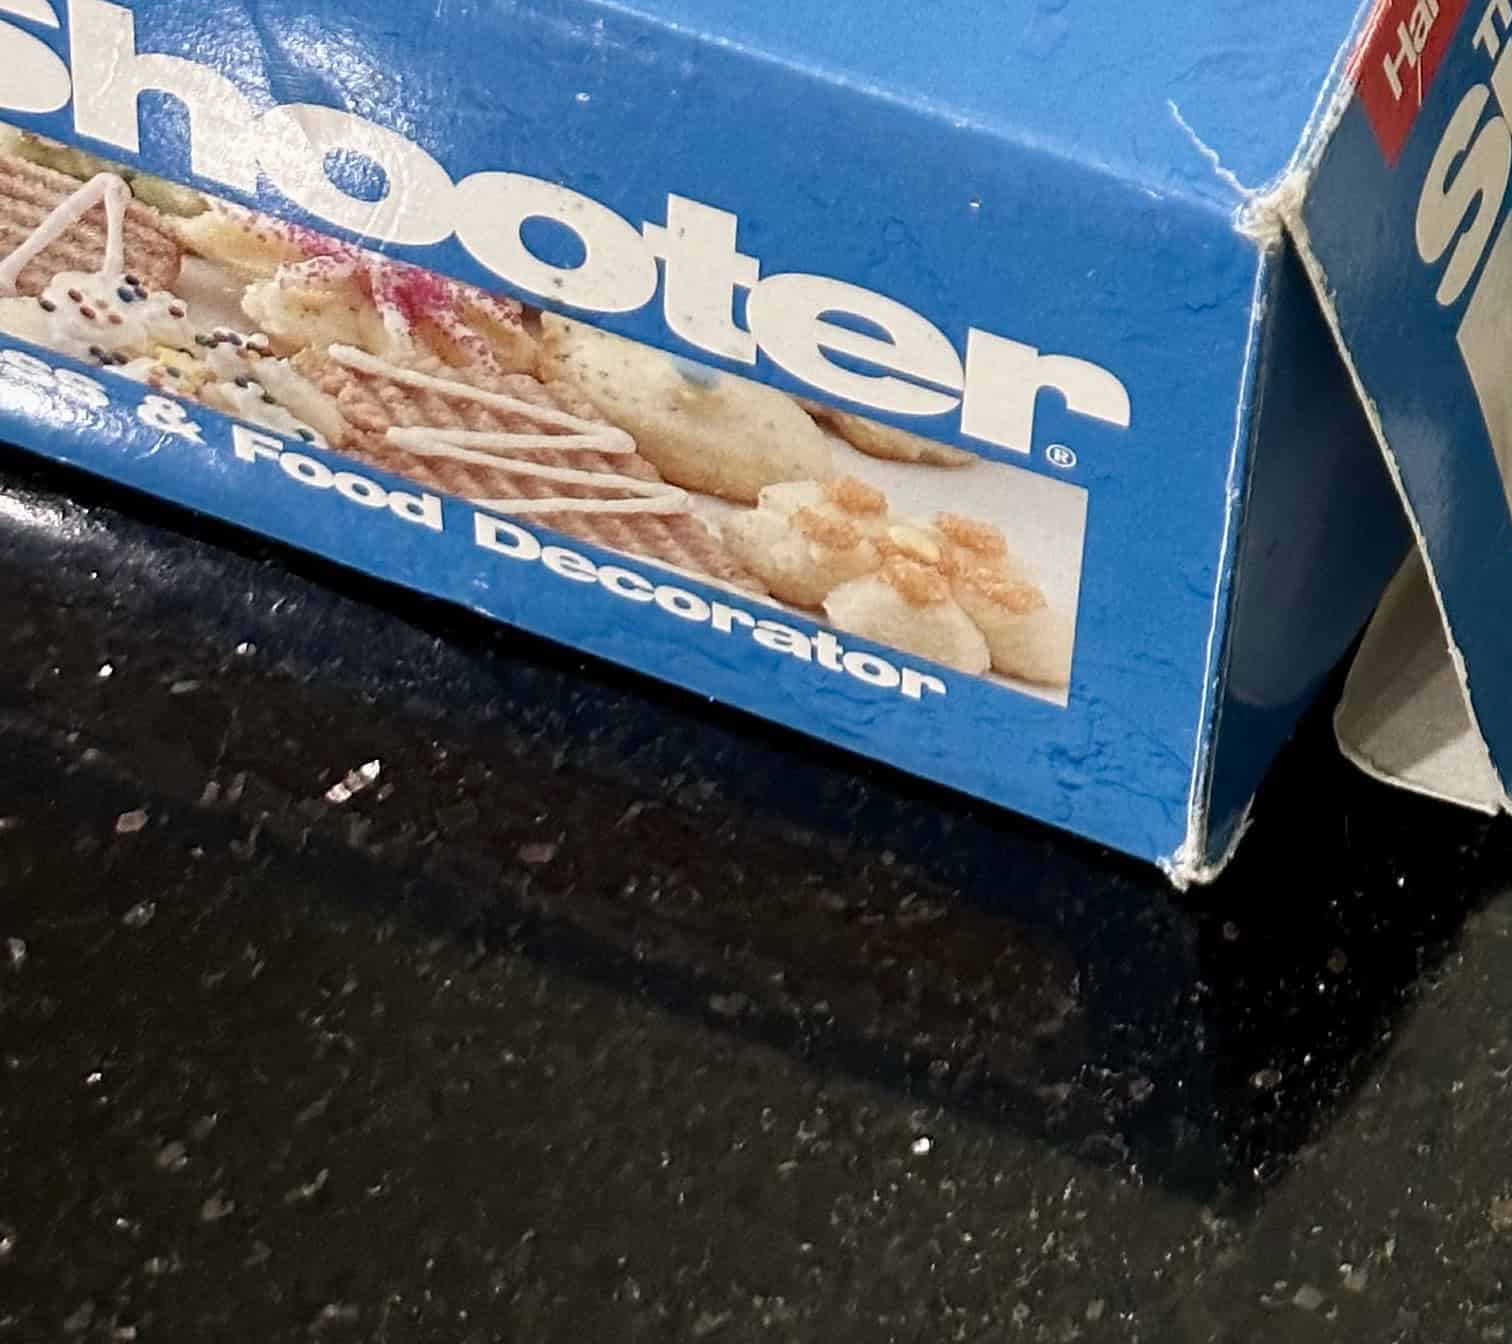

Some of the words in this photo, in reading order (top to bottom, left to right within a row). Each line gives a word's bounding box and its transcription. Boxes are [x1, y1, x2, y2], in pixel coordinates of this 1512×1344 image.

[137, 394, 206, 445] &
[232, 423, 444, 532] Food
[473, 507, 949, 699] Decorator
